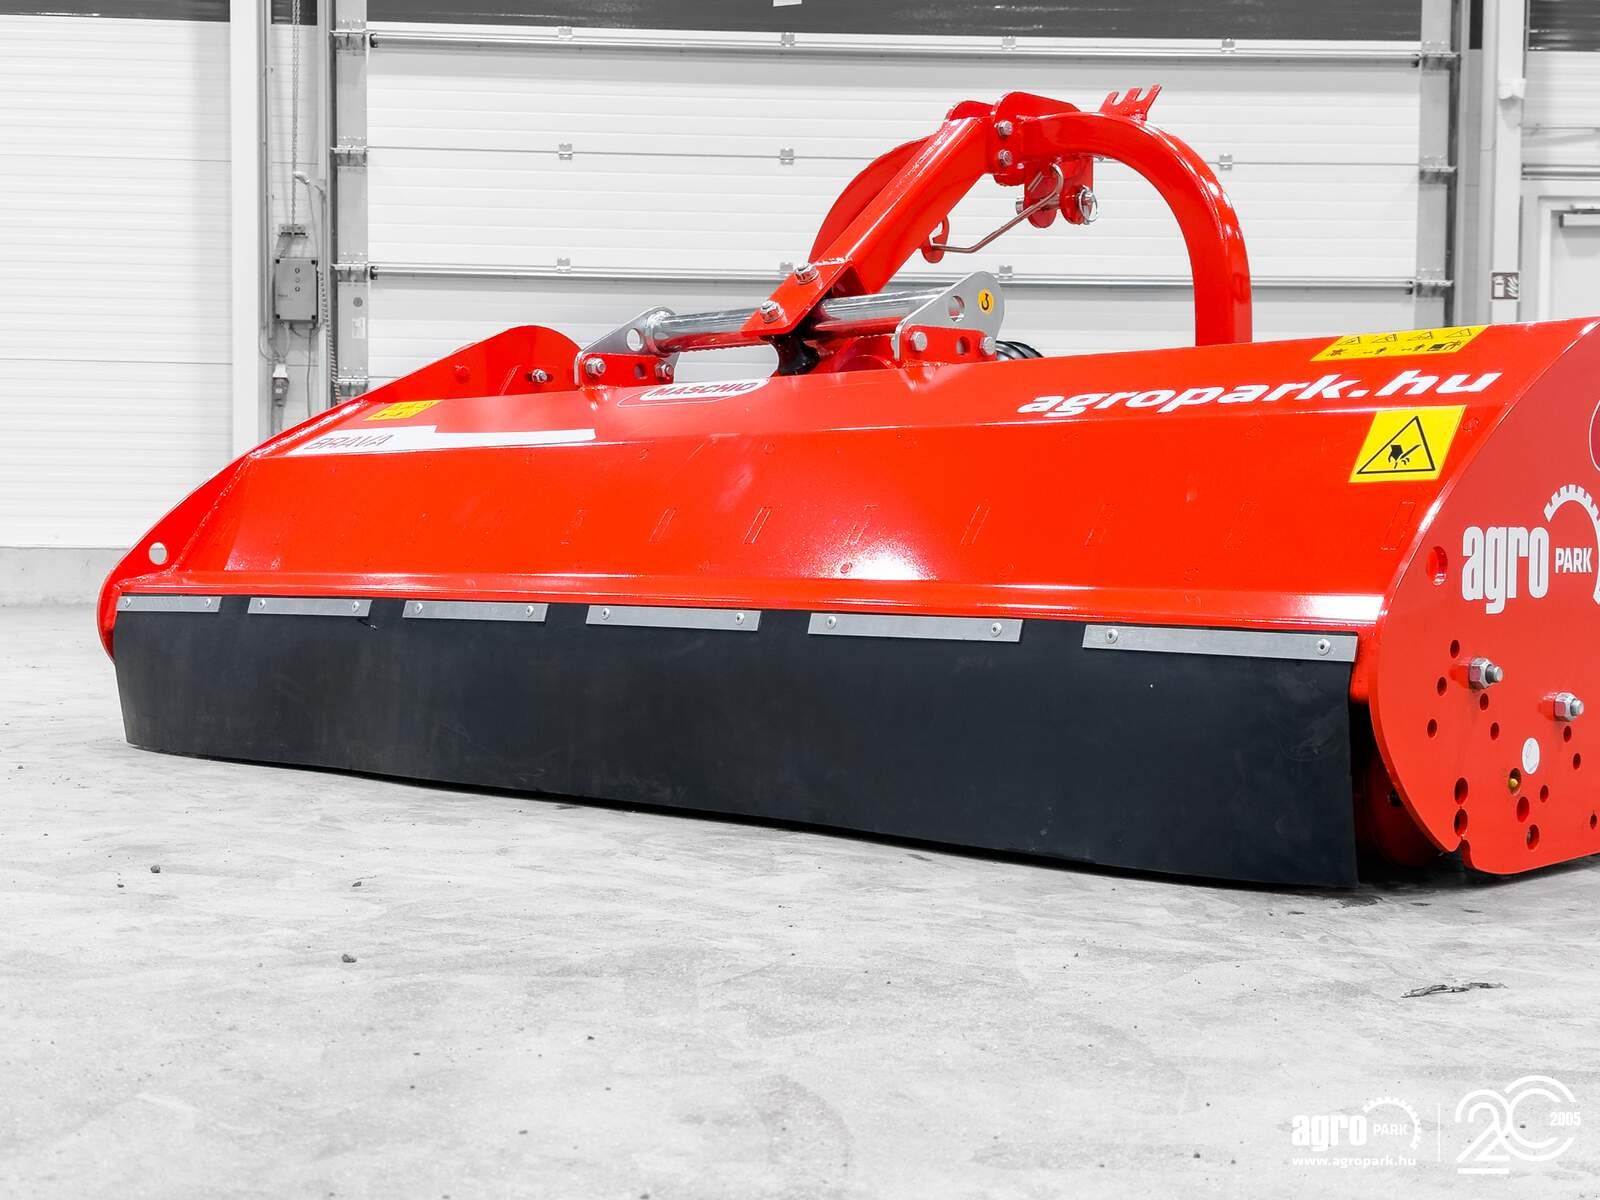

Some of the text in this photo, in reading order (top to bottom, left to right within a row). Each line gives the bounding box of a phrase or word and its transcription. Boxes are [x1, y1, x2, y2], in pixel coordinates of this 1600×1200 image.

[648, 382, 759, 397] MASCHIO
[1017, 369, 1503, 418] agropark.hu
[1461, 525, 1593, 615] agro PARK
